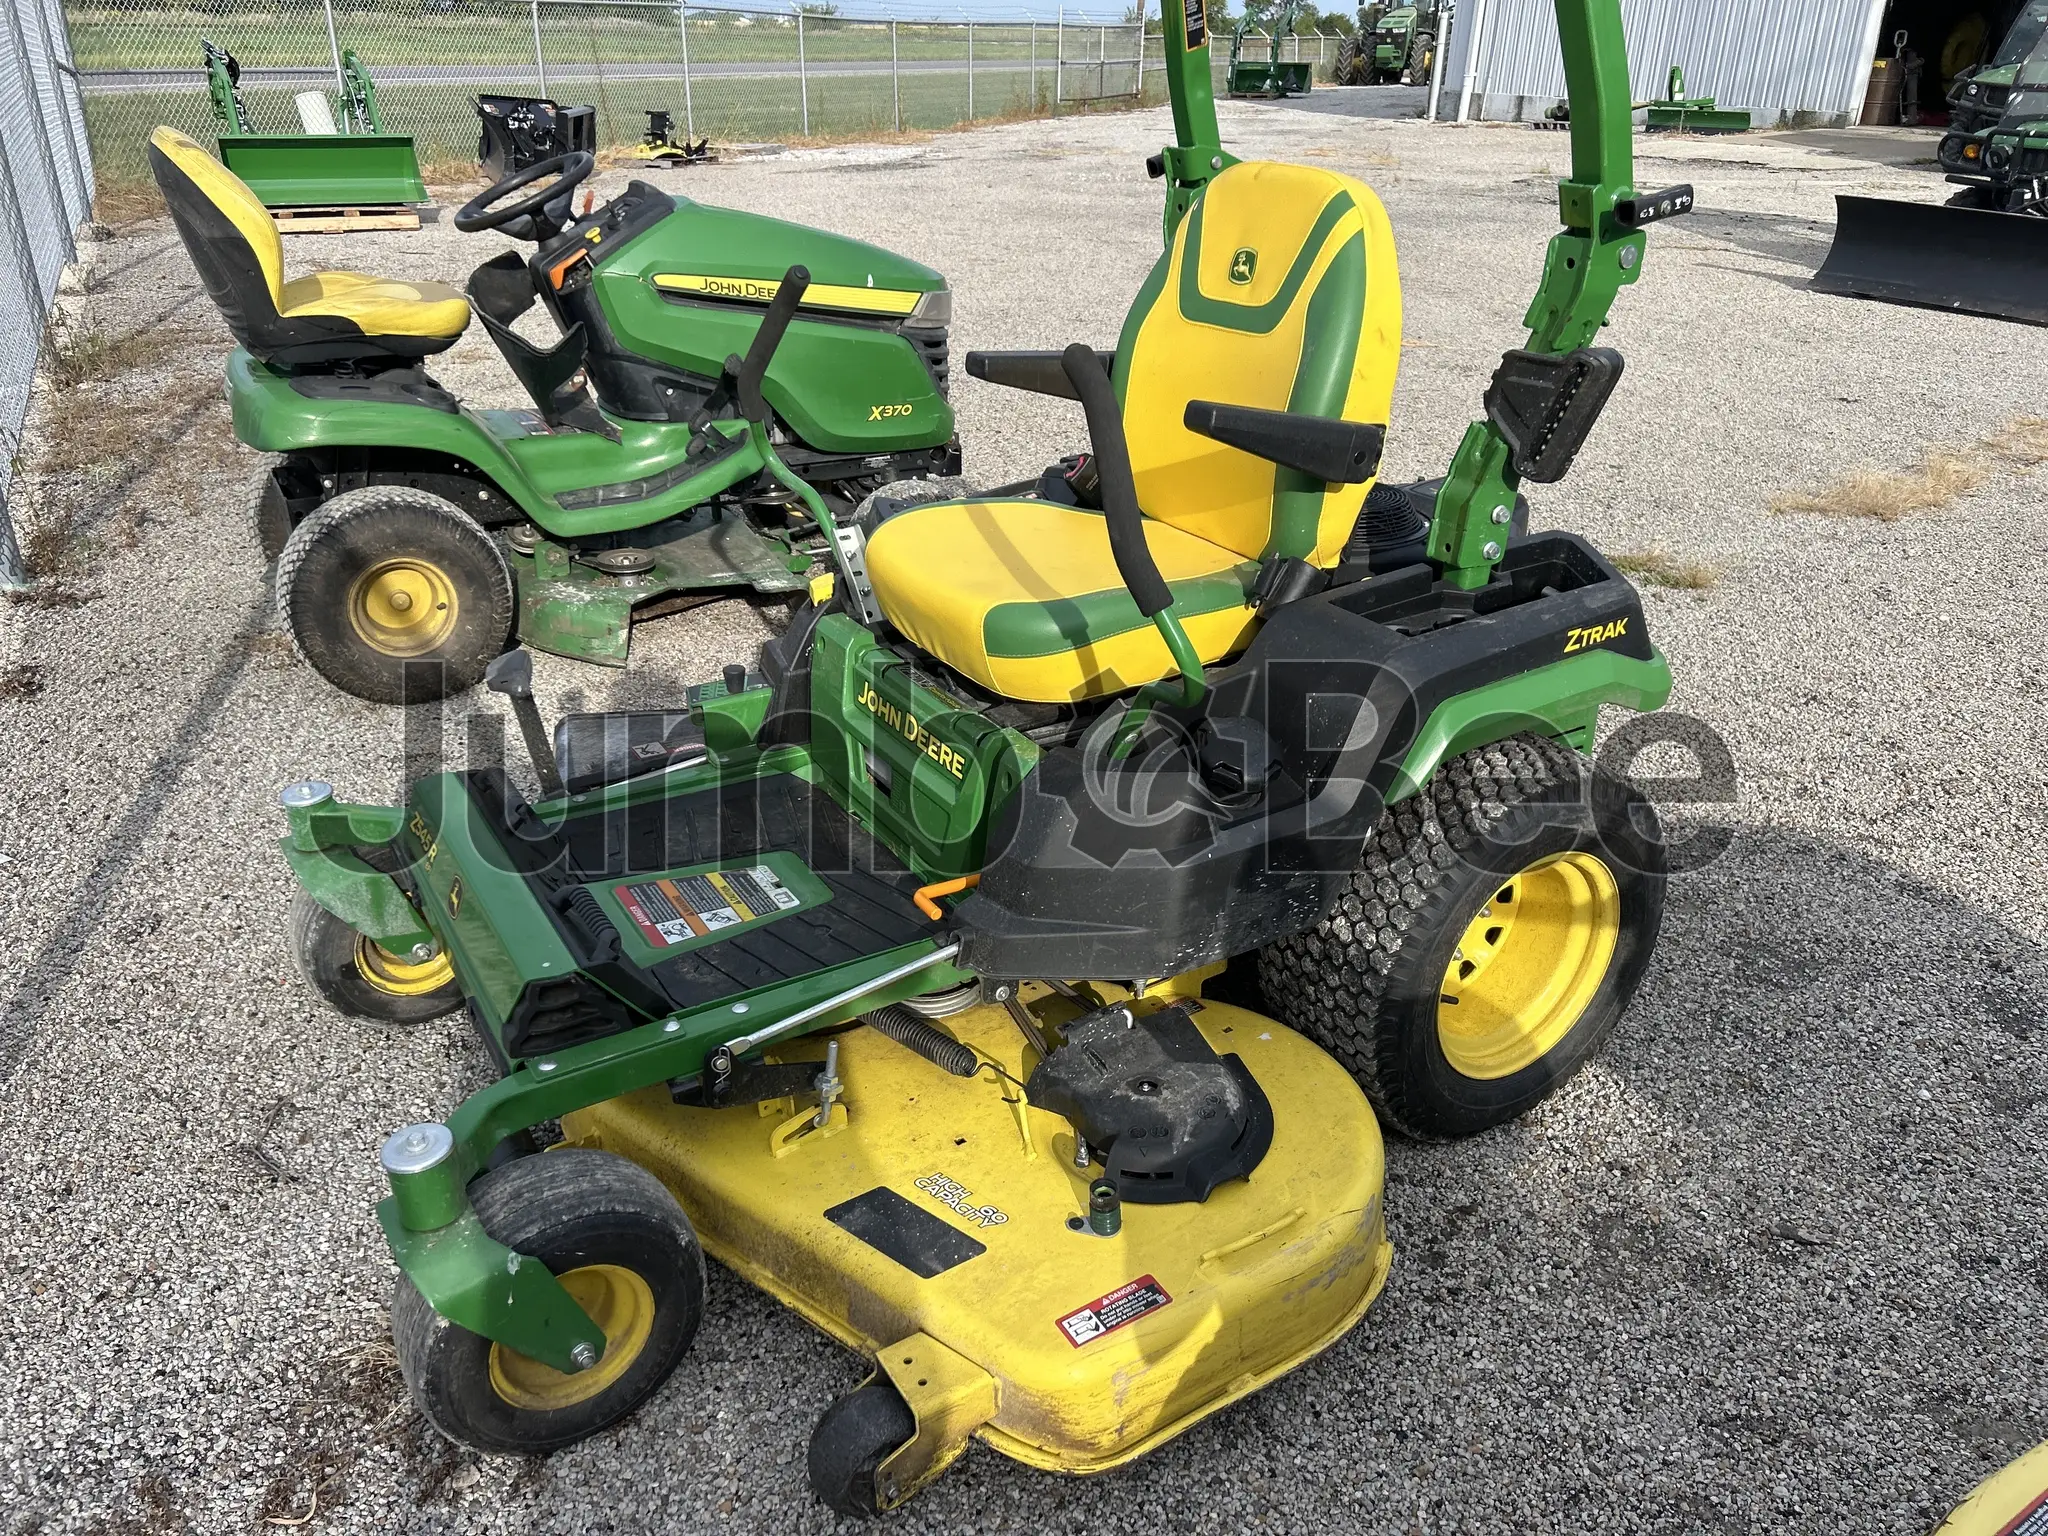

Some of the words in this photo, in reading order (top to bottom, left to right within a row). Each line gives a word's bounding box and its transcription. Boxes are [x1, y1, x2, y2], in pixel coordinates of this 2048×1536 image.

[700, 278, 742, 295] JOHN
[746, 283, 776, 298] DEE
[867, 403, 913, 421] X370
[1563, 617, 1629, 653] ZTRAK
[858, 681, 902, 732] JOHN
[904, 712, 965, 780] DEERE
[914, 1177, 998, 1228] CAPACITY
[929, 1172, 973, 1200] HIGH
[980, 1205, 1009, 1224] 60
[1108, 1283, 1138, 1301] DANGER
